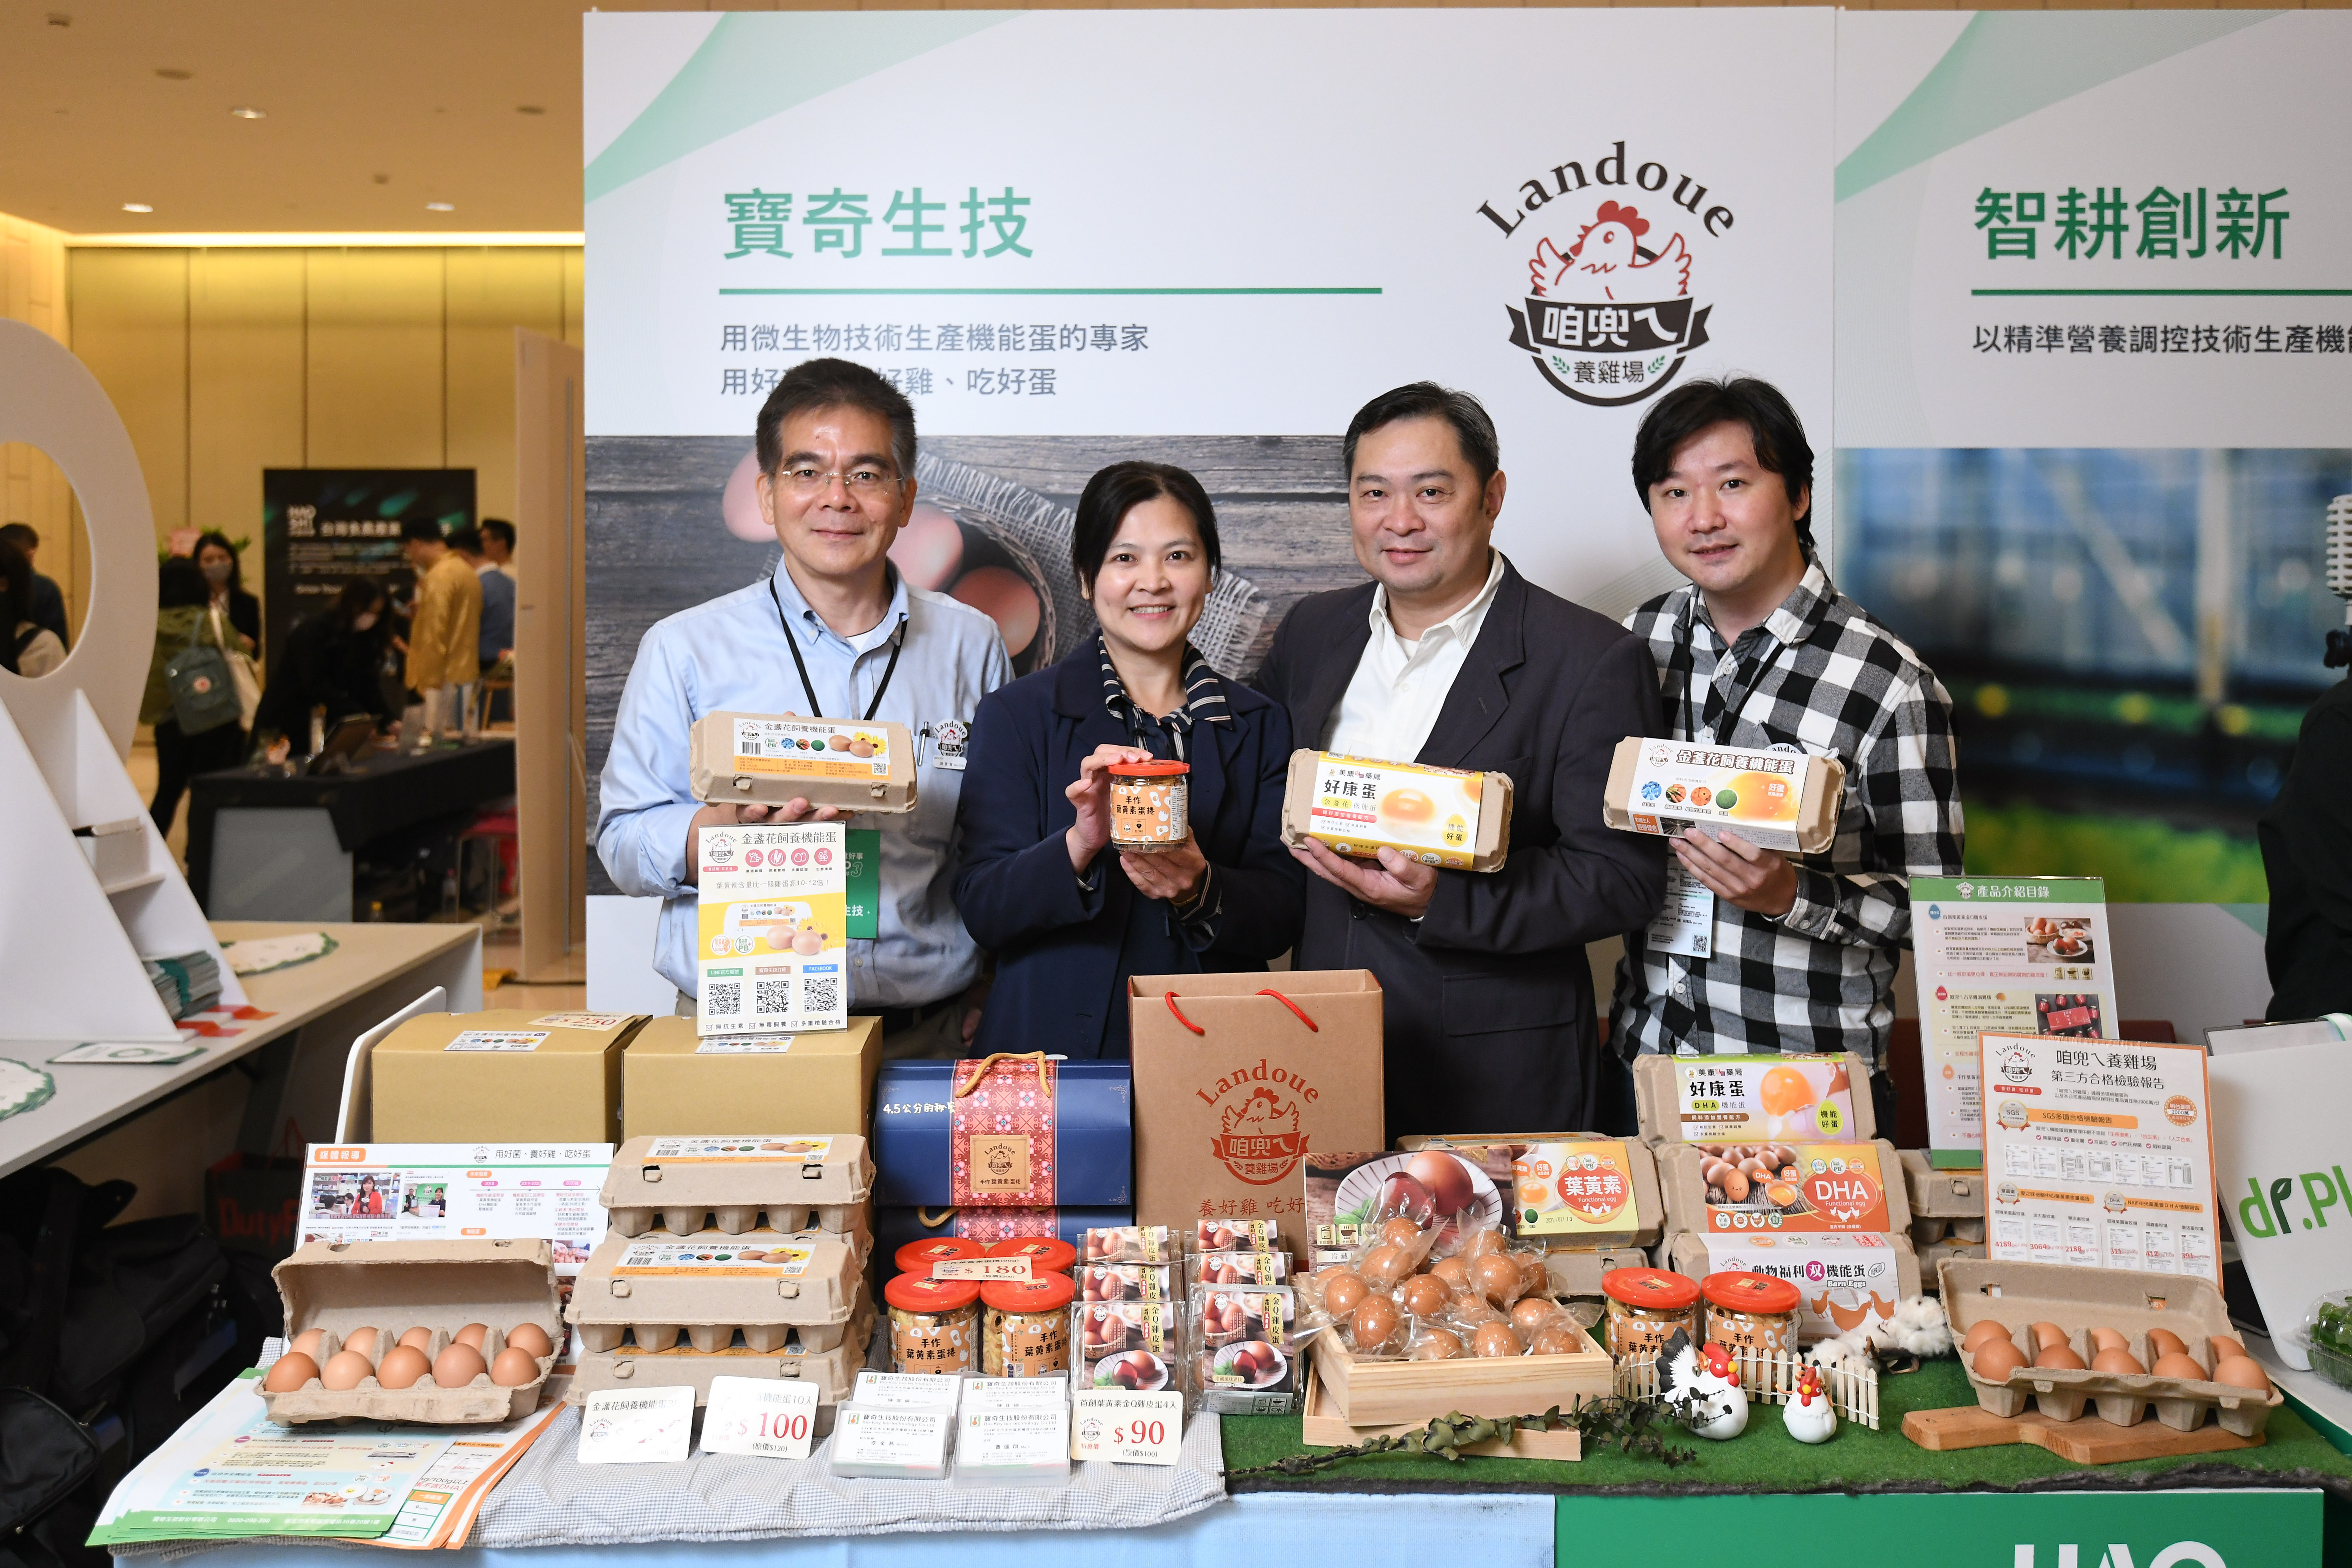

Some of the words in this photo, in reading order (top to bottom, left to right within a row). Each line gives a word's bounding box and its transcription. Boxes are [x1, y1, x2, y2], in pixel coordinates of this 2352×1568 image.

[1476, 141, 1734, 239] Landoue
[723, 187, 1034, 259] 寶奇生技
[1975, 186, 2289, 260] 智耕創新
[721, 324, 1149, 352] 用微生物技術生產機能蛋的專家
[1973, 324, 2352, 353] 以精準營養調控技術生產機
[1574, 361, 1644, 384] 養雞場
[765, 723, 836, 734] 金盞花飼養機能蛋
[935, 721, 966, 736] Landoue
[1676, 749, 1794, 774] 金盞花飼養機能蛋
[1324, 779, 1376, 800] 好康蛋
[1768, 783, 1785, 792] 好蛋
[1125, 796, 1141, 805] 手作
[1324, 798, 1349, 808] 金盞花
[1448, 823, 1464, 832] 機能
[705, 831, 737, 844] Landoue
[741, 831, 836, 845] 金盞花飼養機能蛋
[1446, 833, 1463, 842] 好蛋
[1977, 885, 2050, 898] 產品介紹目錄
[575, 1018, 616, 1026] 250
[1995, 1043, 2035, 1059] Landoue
[1196, 1059, 1319, 1107] Landoue
[2051, 1070, 2165, 1089] 第三方合格檢驗報告
[1690, 1080, 1745, 1097] 好康蛋
[1821, 1110, 1838, 1119] 機能
[2042, 1112, 2112, 1124] SGS多項合格檢驗報告
[1821, 1119, 1838, 1129] 好蛋
[495, 1149, 591, 1159] 用好菌、養好雞、吃好蛋
[984, 1143, 1015, 1155] Landoue
[319, 1151, 360, 1160] 媒體報導
[1244, 1162, 1279, 1174] 養雞場
[1564, 1175, 1622, 1196] 葉黃素
[1815, 1180, 1869, 1200] DHA
[1200, 1199, 1258, 1217] 養好雞
[1720, 1256, 1747, 1268] Landoue
[983, 1265, 1026, 1274] 180
[1848, 1279, 1867, 1289] Eggs
[1040, 1330, 1058, 1343] 手作
[1644, 1333, 1664, 1342] 手作
[1733, 1333, 1754, 1345] 手作
[920, 1338, 941, 1348] 手作
[1080, 1399, 1177, 1409] 首創葉黃素金Q雞皮蛋4入
[863, 1414, 936, 1423] 寶奇生技股份有限公司
[1080, 1417, 1103, 1426] Landoue
[738, 1419, 749, 1436] $
[759, 1412, 807, 1440] 100
[1114, 1426, 1123, 1444] $
[1131, 1420, 1164, 1445] 90
[752, 1442, 787, 1453] (原價$120)
[1122, 1449, 1157, 1458] (原價$100)
